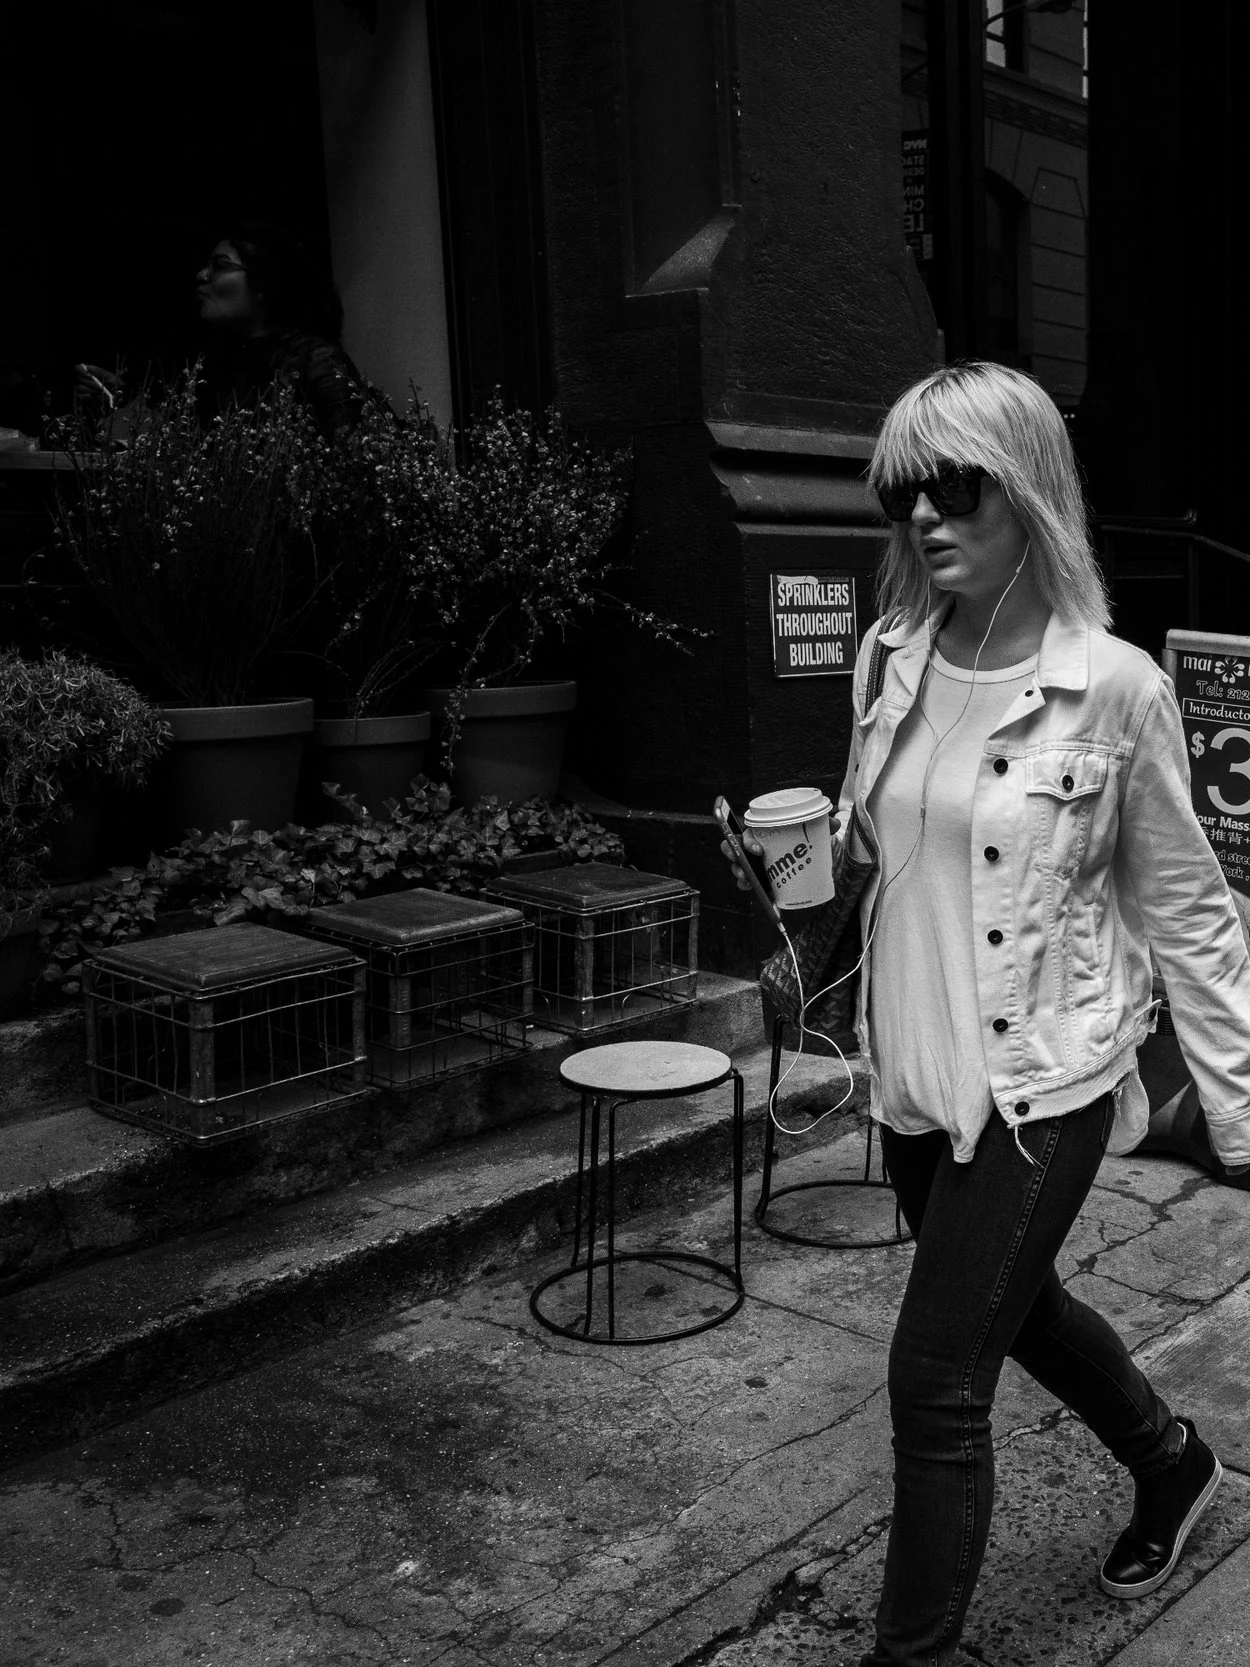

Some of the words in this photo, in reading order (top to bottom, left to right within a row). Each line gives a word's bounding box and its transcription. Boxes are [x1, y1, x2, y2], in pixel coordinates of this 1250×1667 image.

[778, 583, 849, 606] SPRINKLERS
[776, 612, 853, 637] THROUGHOUT
[789, 641, 844, 667] BUILDING
[1183, 655, 1212, 672] mai
[1196, 680, 1224, 698] Tel:
[1195, 811, 1216, 826] our
[776, 857, 812, 888] coffee
